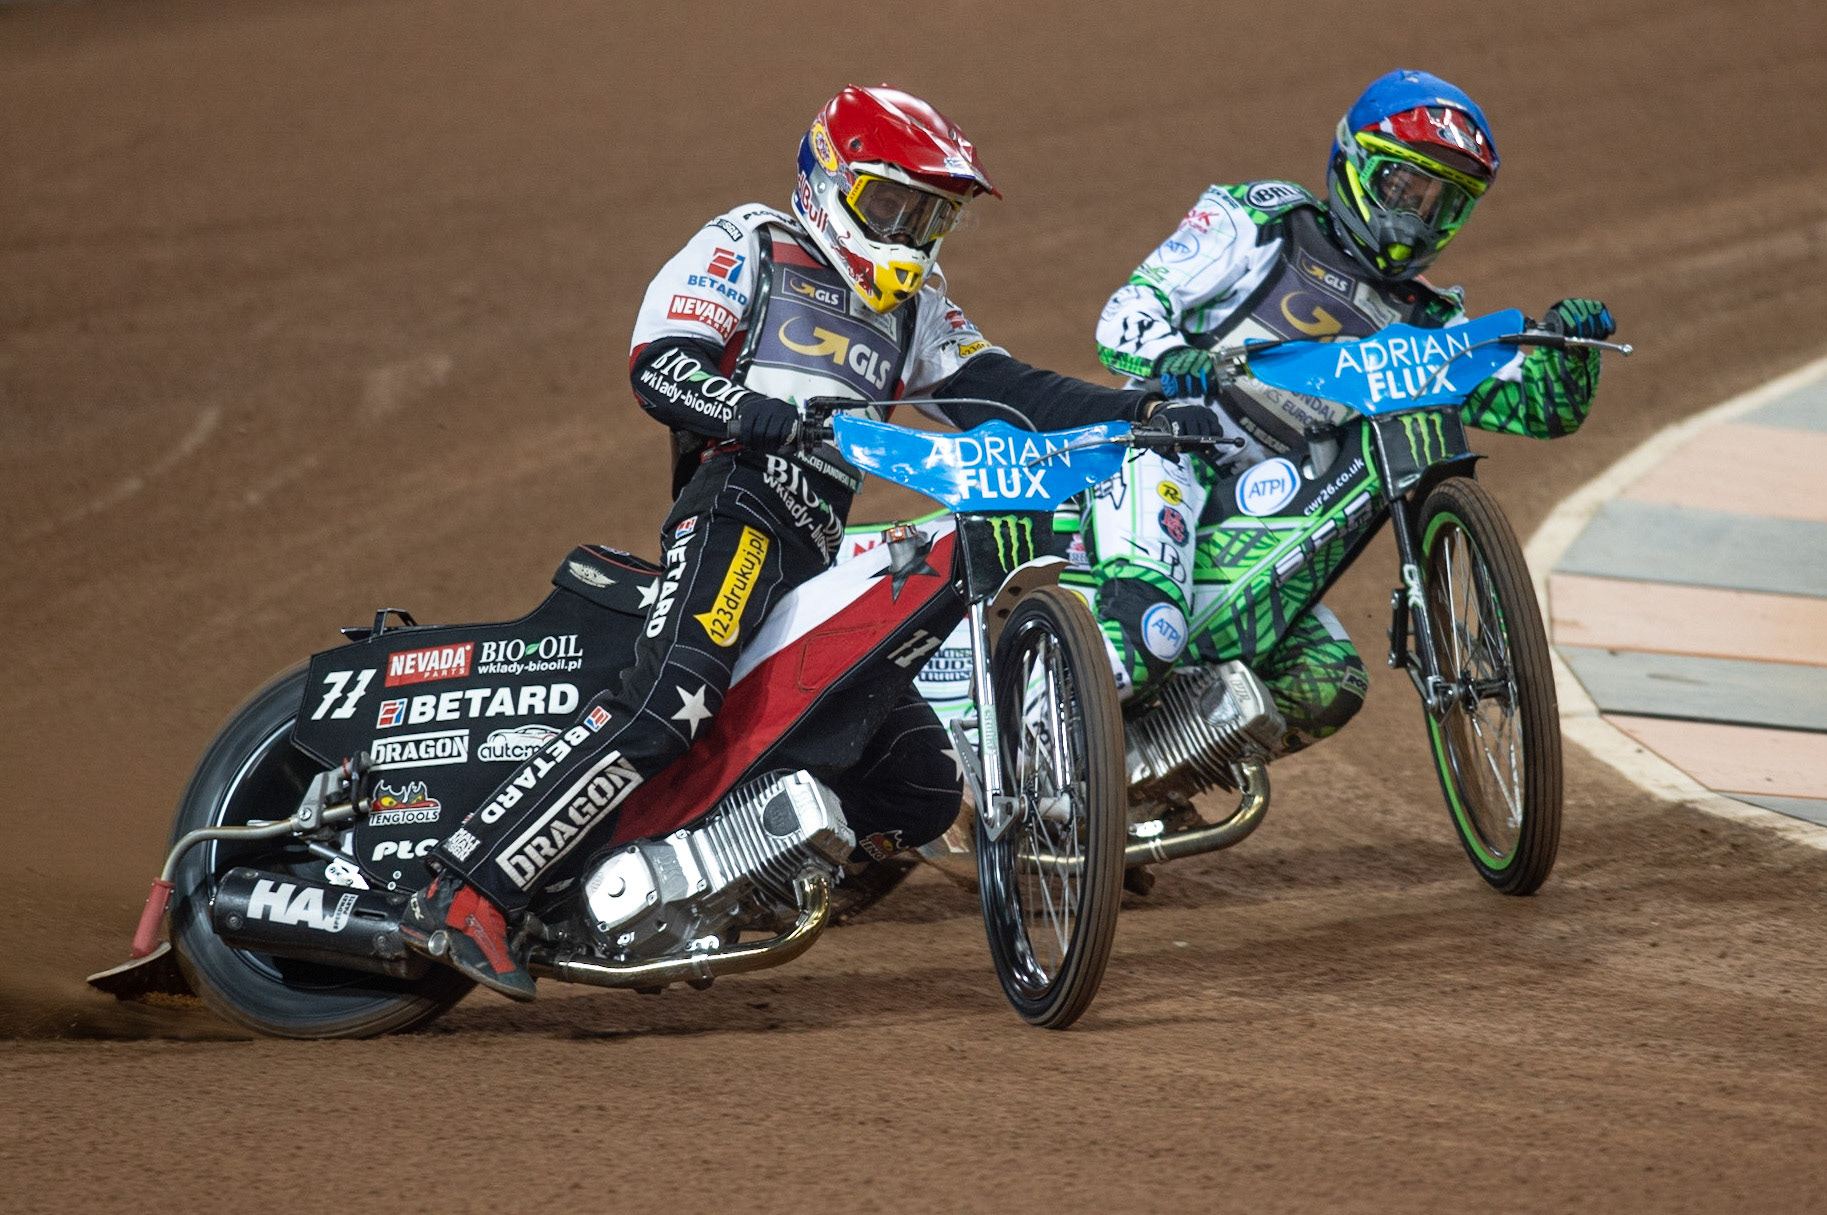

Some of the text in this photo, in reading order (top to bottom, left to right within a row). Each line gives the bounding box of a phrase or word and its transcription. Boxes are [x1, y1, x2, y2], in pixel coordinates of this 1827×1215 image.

[687, 274, 748, 306] BETARD
[815, 289, 839, 305] GLS
[1324, 273, 1348, 292] GLS
[671, 297, 735, 333] NEVADA
[849, 343, 892, 390] GLS
[1335, 332, 1473, 378] ADRIAN
[640, 370, 734, 424] wklady-biooil.p
[1367, 365, 1457, 402] FLUX
[926, 436, 1071, 470] ADRIAN
[961, 469, 1050, 500] FLUX
[1248, 478, 1286, 499] ATPI
[1304, 457, 1365, 517] cwr26.co.uk
[710, 531, 765, 640] 123drukuj.pl
[1151, 617, 1182, 643] ATPI
[389, 647, 466, 677] NEVADA
[424, 667, 465, 679] PARTS
[478, 658, 583, 676] wklady-biooil.pl
[311, 669, 377, 720] 71
[408, 683, 579, 725] BETARD
[372, 735, 470, 765] DRAGON
[480, 725, 590, 824] BETARD
[508, 756, 638, 887] DRAGON
